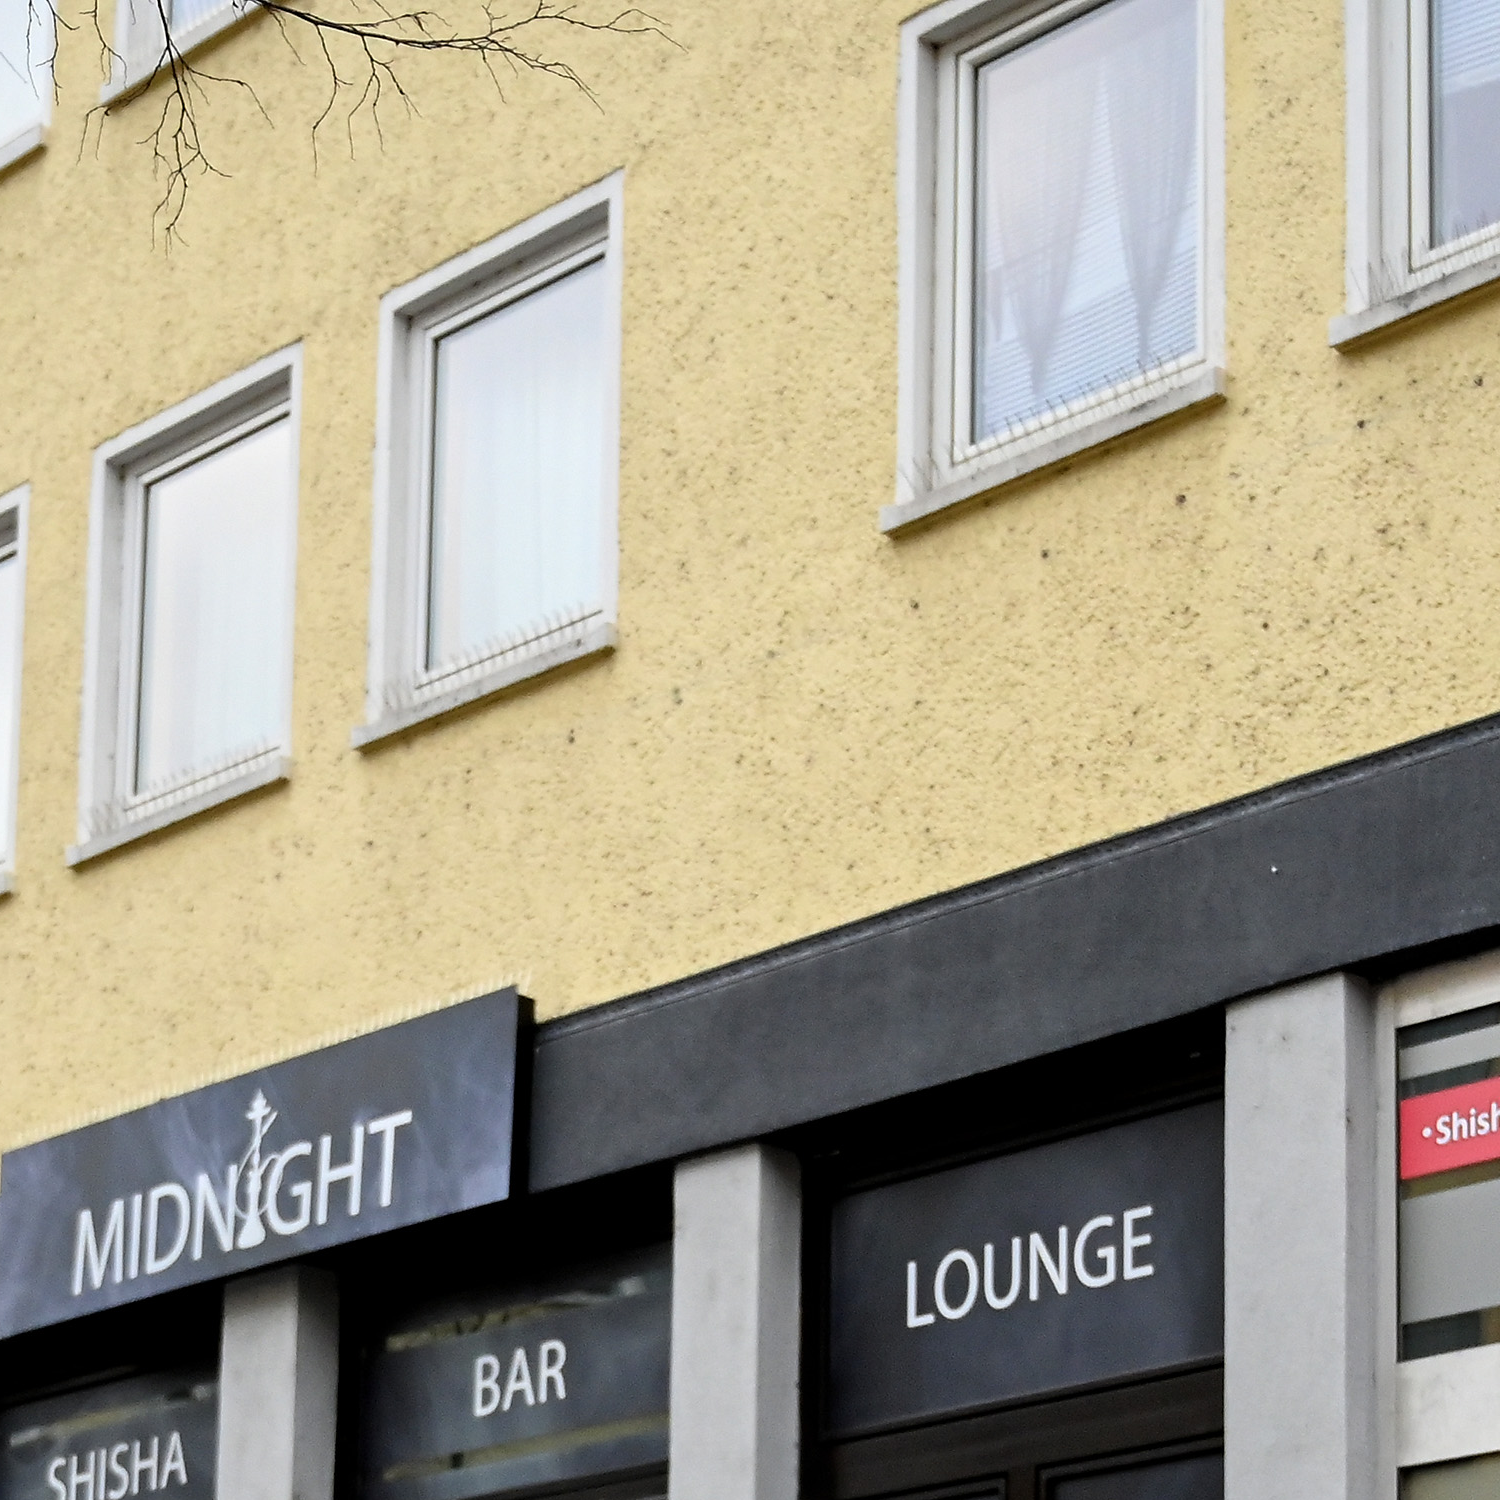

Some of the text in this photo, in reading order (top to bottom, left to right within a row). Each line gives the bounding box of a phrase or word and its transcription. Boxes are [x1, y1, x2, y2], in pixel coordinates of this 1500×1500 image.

[71, 1090, 412, 1296] MIDNIGHT
[905, 1205, 1155, 1329] LOUNGE
[472, 1340, 568, 1418] BAR
